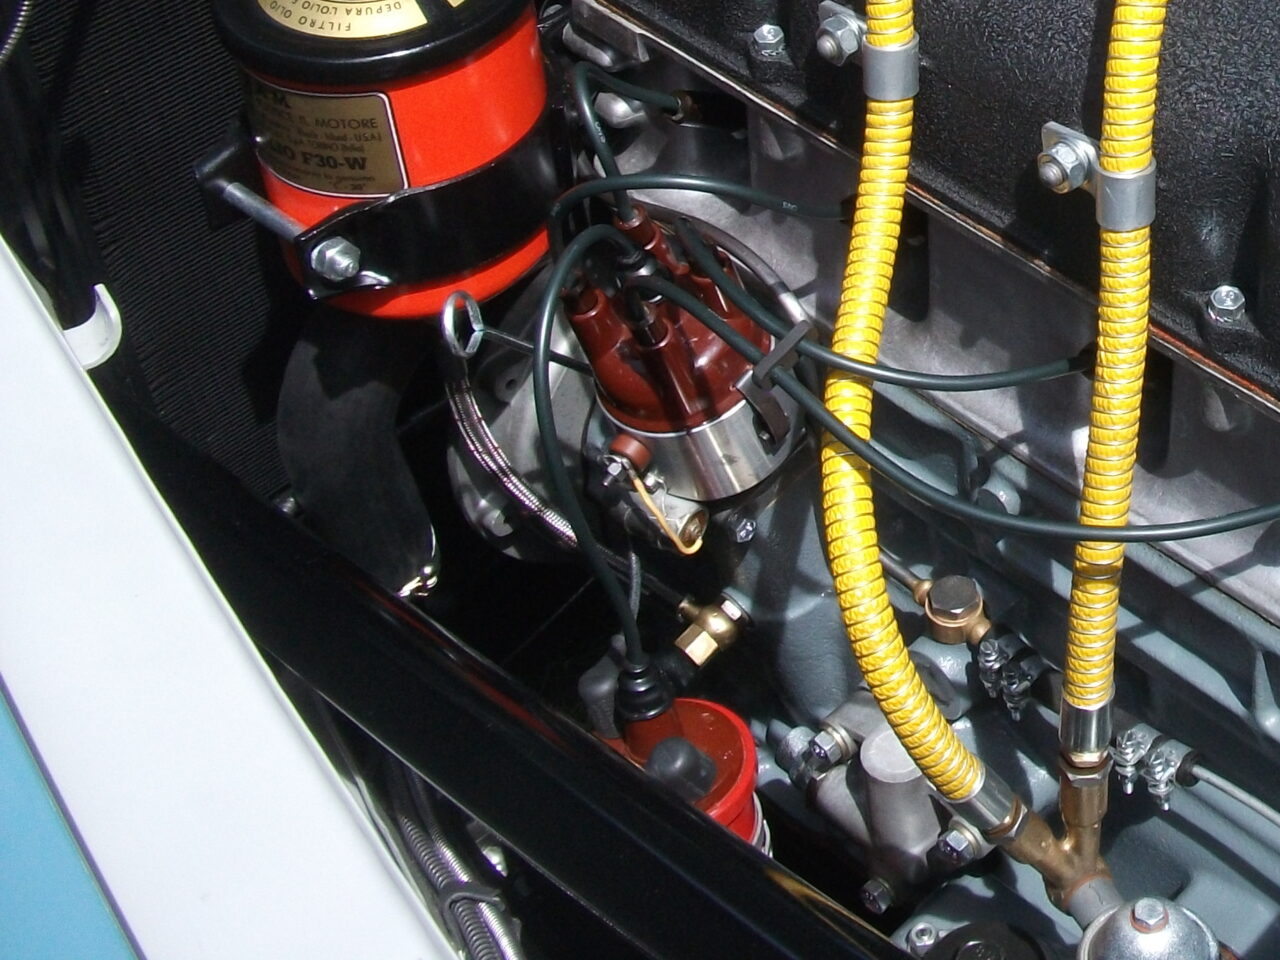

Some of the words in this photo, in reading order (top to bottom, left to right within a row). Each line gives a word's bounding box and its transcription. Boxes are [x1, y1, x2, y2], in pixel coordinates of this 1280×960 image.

[268, 0, 293, 19] OLIO
[301, 0, 338, 16] L'OLIO
[345, 1, 402, 16] DEPURA
[298, 15, 351, 32] FILTRO
[314, 117, 379, 129] MOTORE
[300, 151, 368, 170] F30-W
